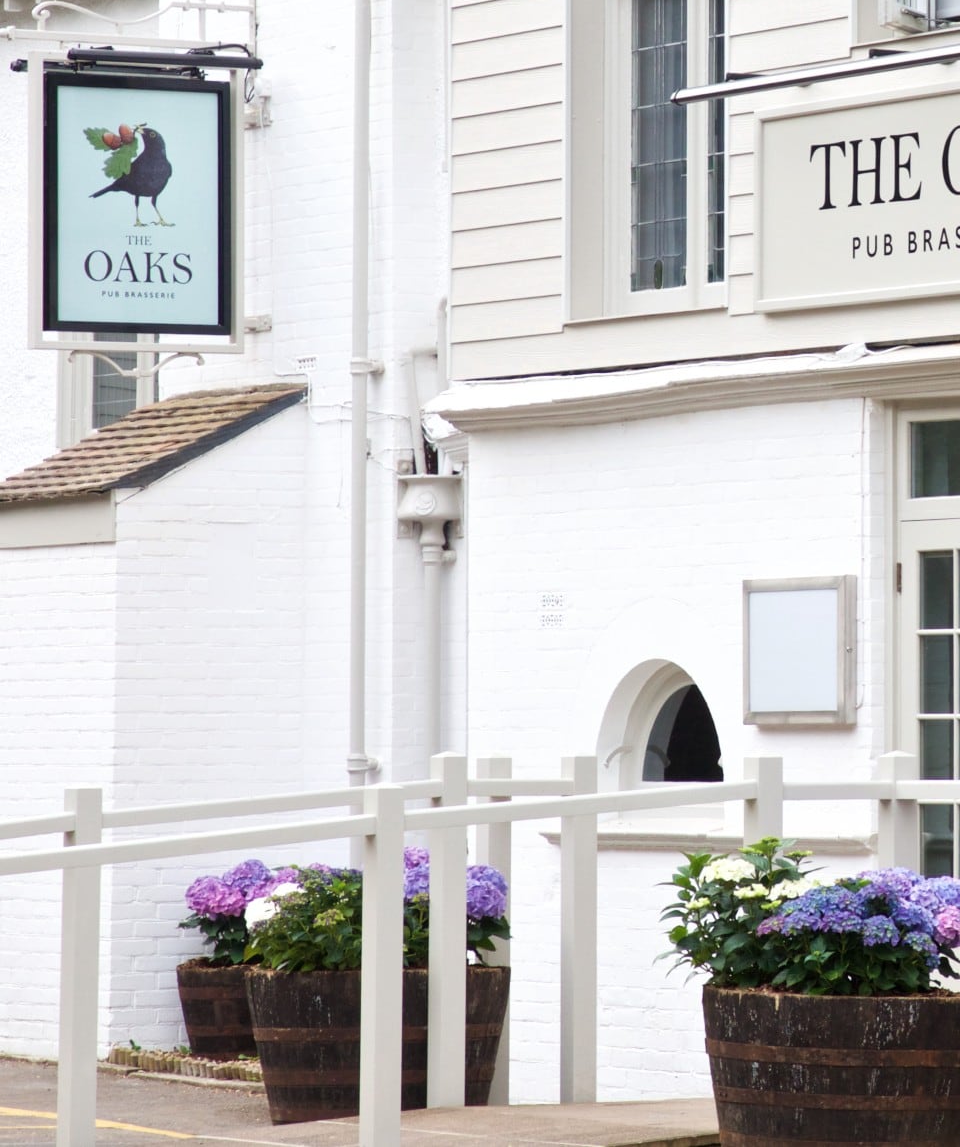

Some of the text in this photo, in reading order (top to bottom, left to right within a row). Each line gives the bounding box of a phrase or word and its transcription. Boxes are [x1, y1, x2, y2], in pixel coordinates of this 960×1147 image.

[809, 131, 923, 211] THE
[125, 235, 152, 246] THE
[852, 233, 894, 260] PUB
[83, 249, 193, 285] OAKS
[101, 290, 176, 300] PUB BRASSERIE
